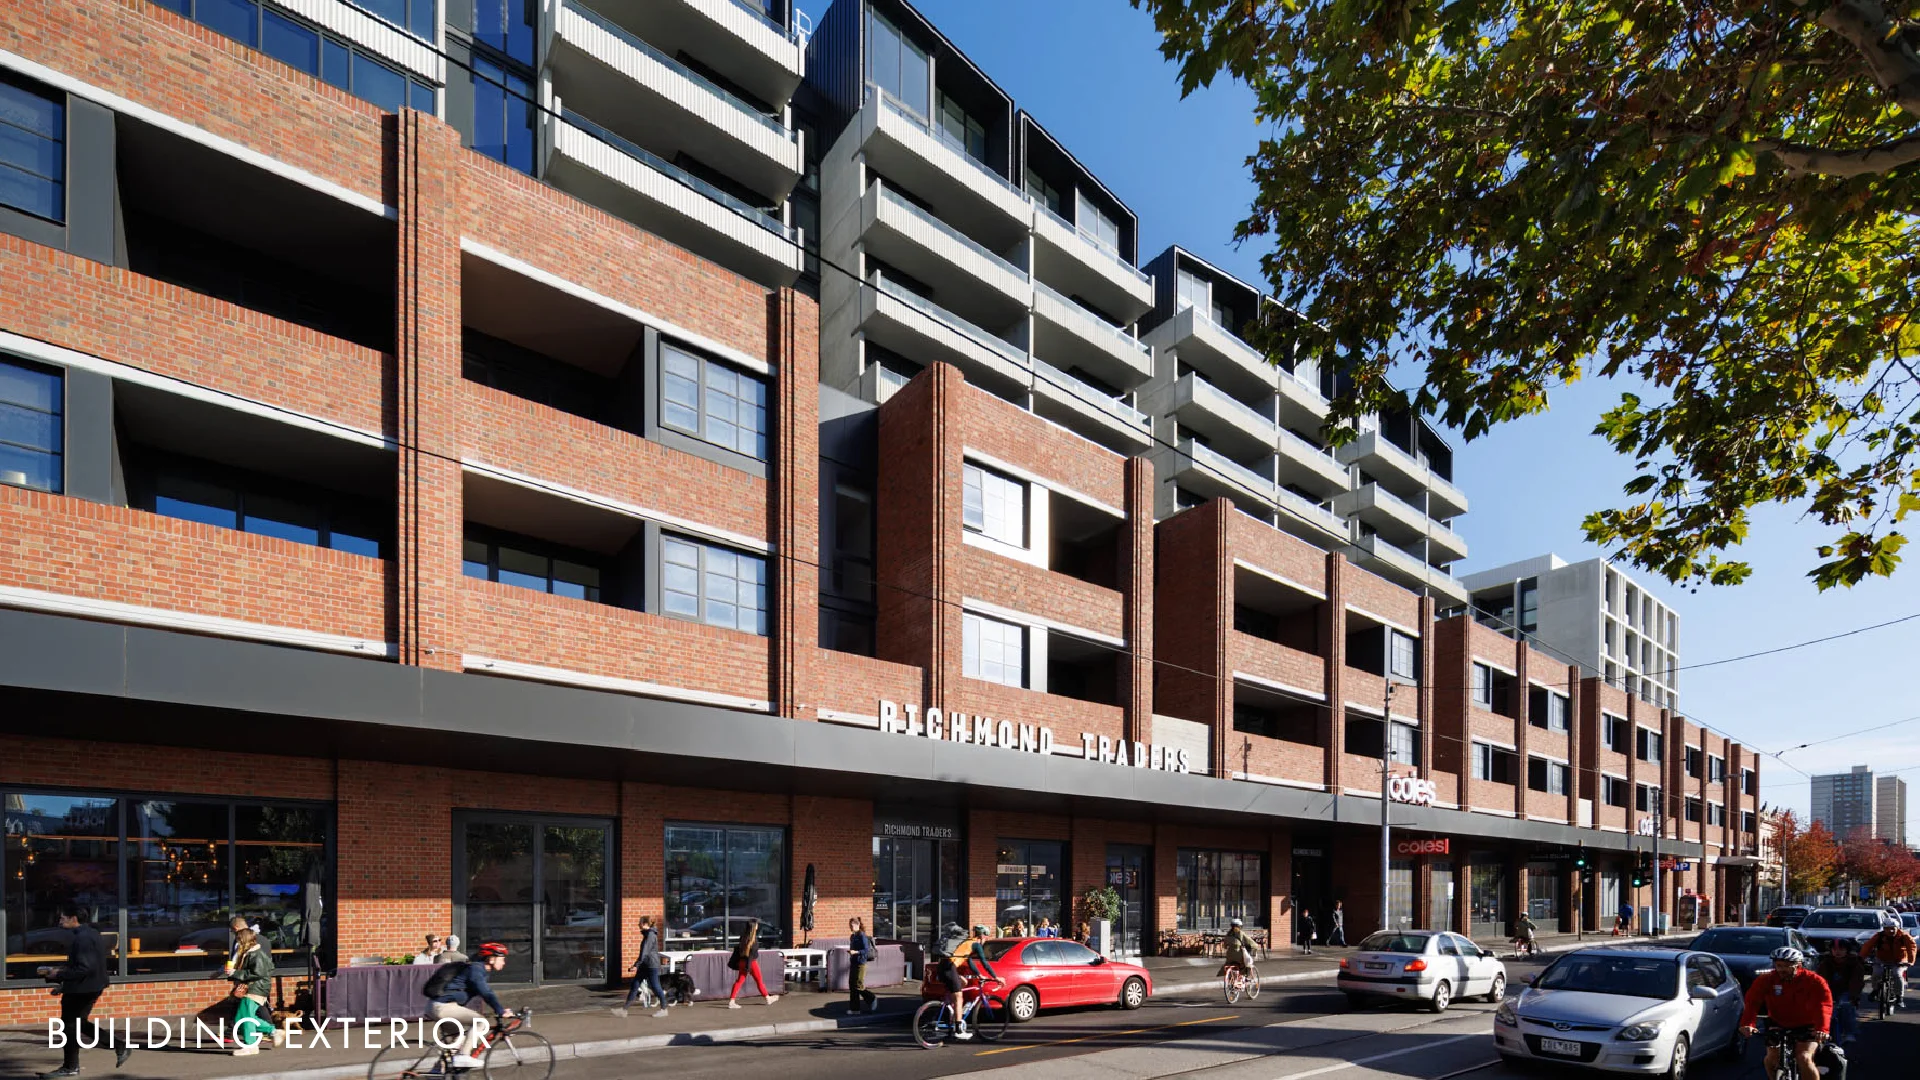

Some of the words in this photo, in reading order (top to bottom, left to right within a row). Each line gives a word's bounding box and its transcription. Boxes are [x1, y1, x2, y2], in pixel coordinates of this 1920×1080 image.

[879, 700, 1054, 756] RICHMOND
[1081, 732, 1190, 775] TRADERS
[1389, 771, 1436, 803] coles
[884, 824, 920, 836] RICHMOND
[922, 826, 952, 838] TRADERS
[1397, 839, 1445, 853] coles
